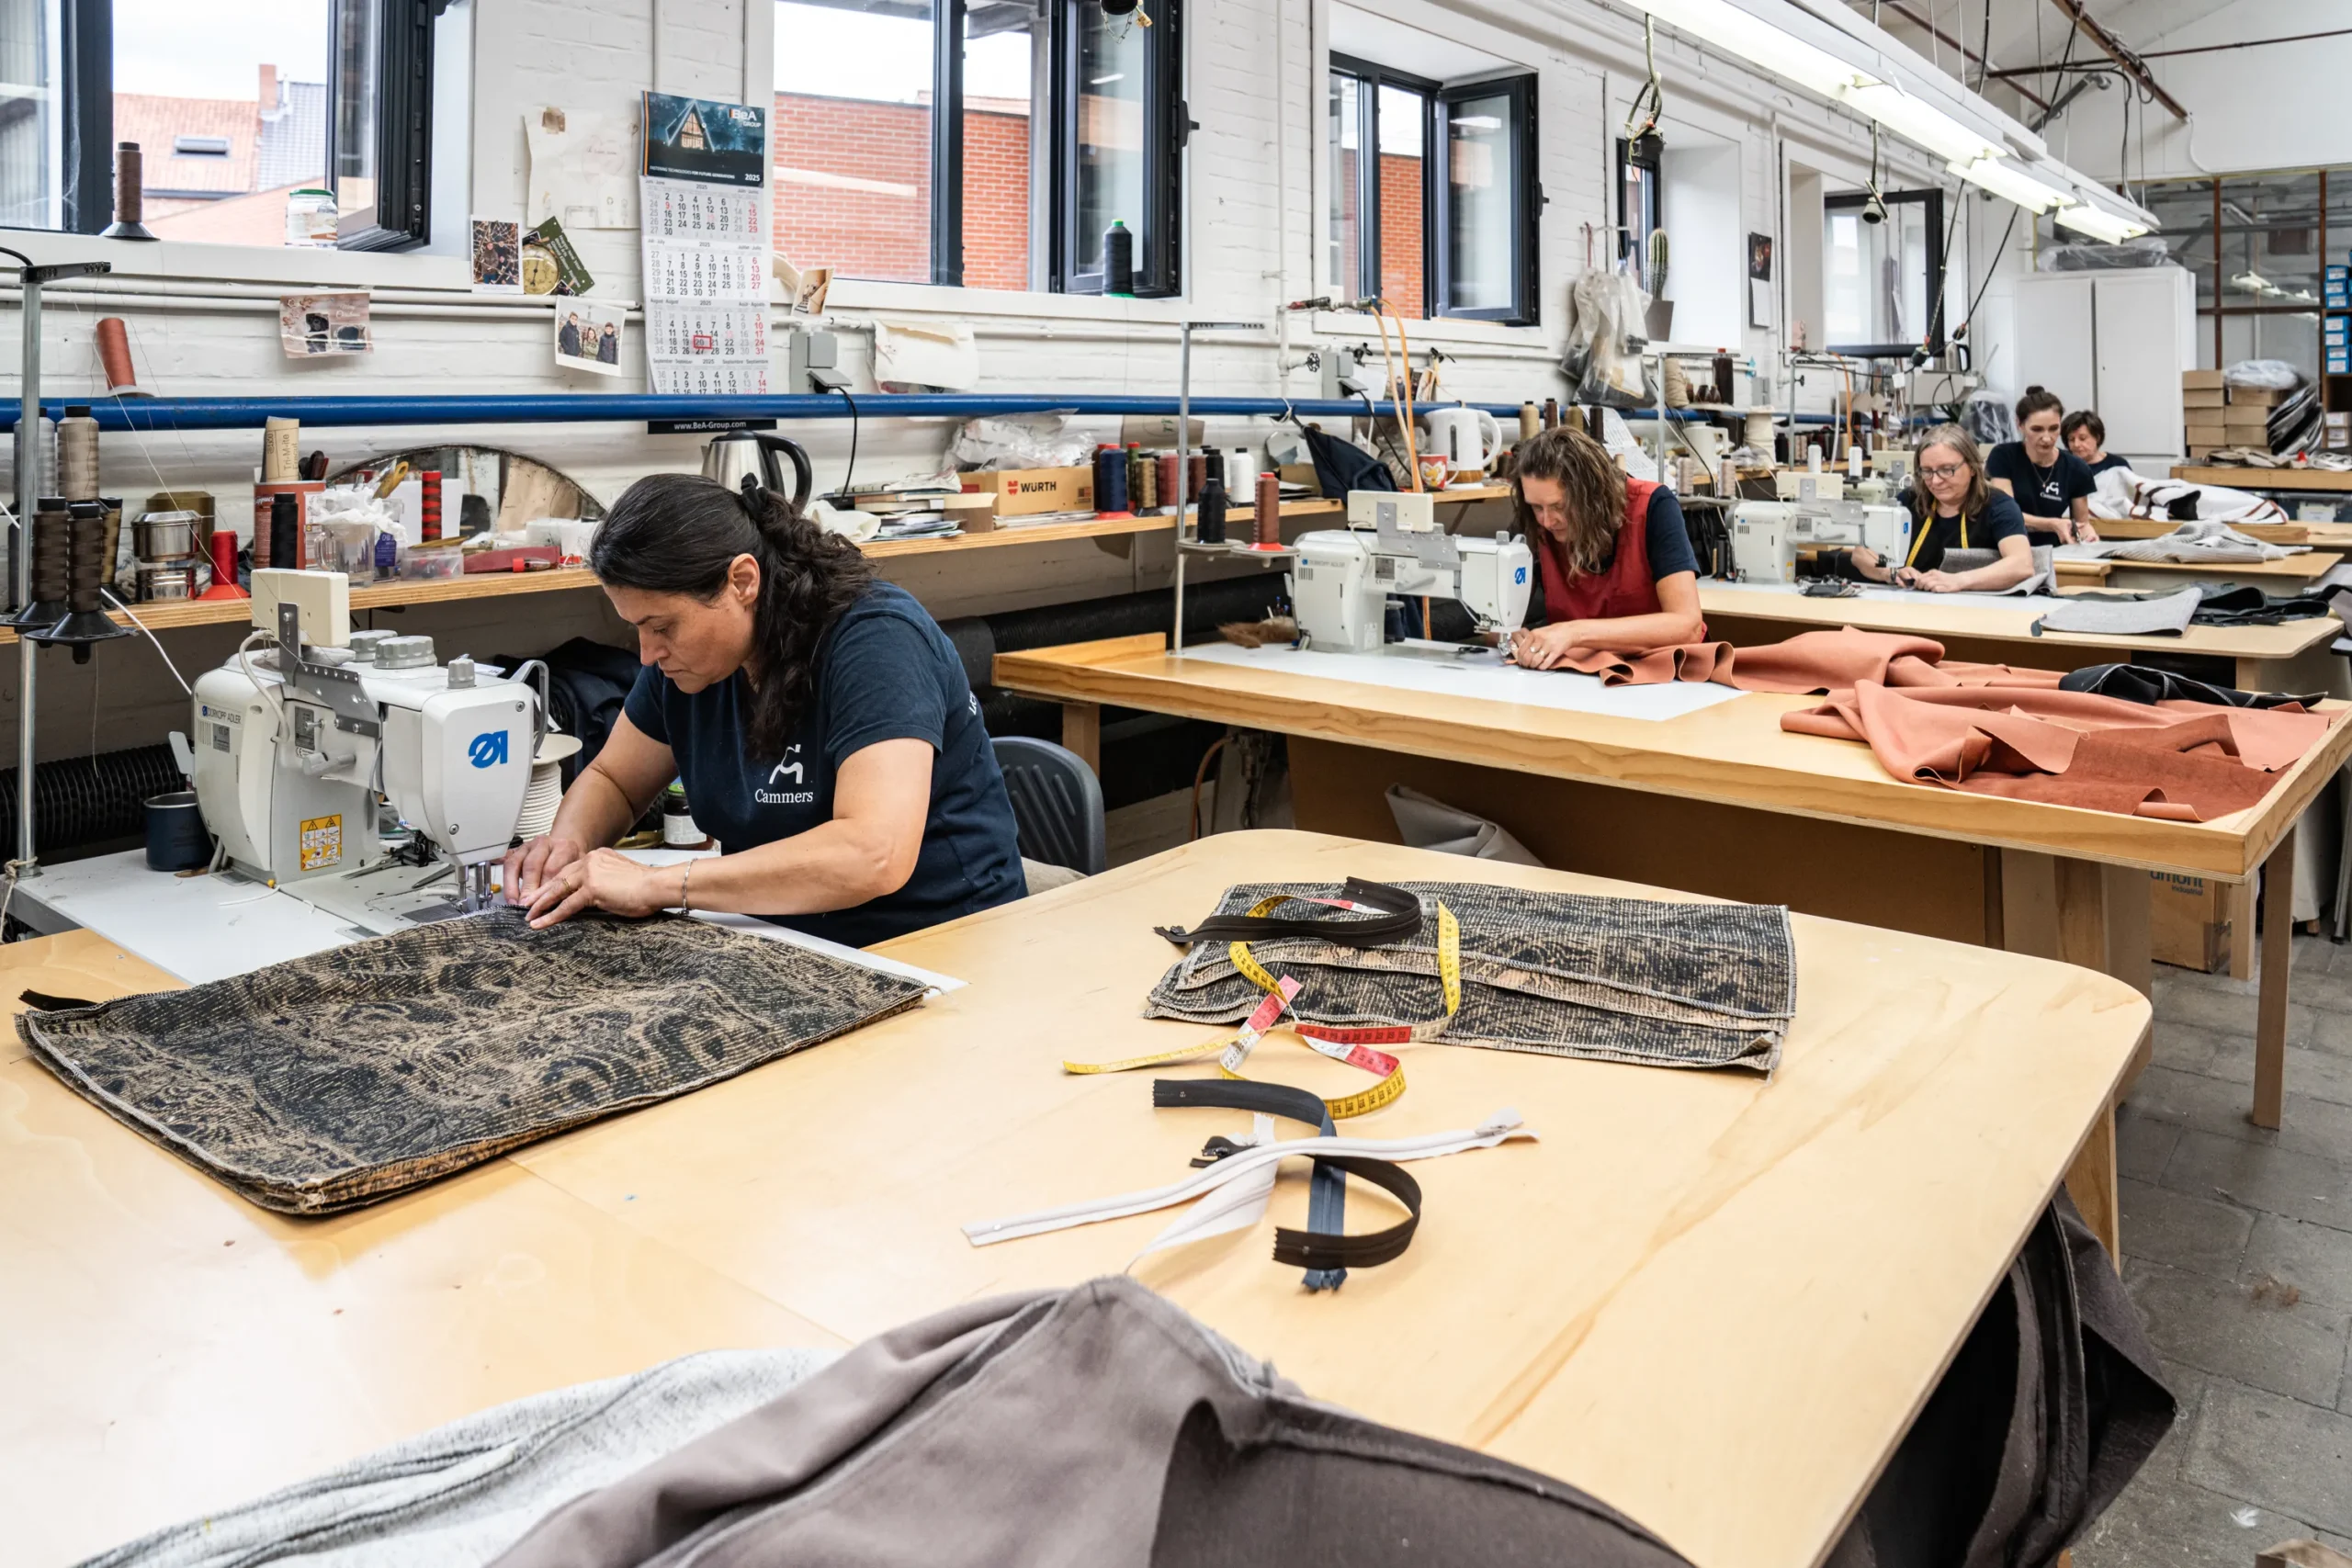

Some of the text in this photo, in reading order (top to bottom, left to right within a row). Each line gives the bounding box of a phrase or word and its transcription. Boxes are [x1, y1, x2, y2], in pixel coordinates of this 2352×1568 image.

[732, 109, 756, 121] BeA
[674, 422, 746, 430] www.BeA-Group.com
[1021, 481, 1056, 492] WÜRTH
[755, 789, 813, 803] Cammers
